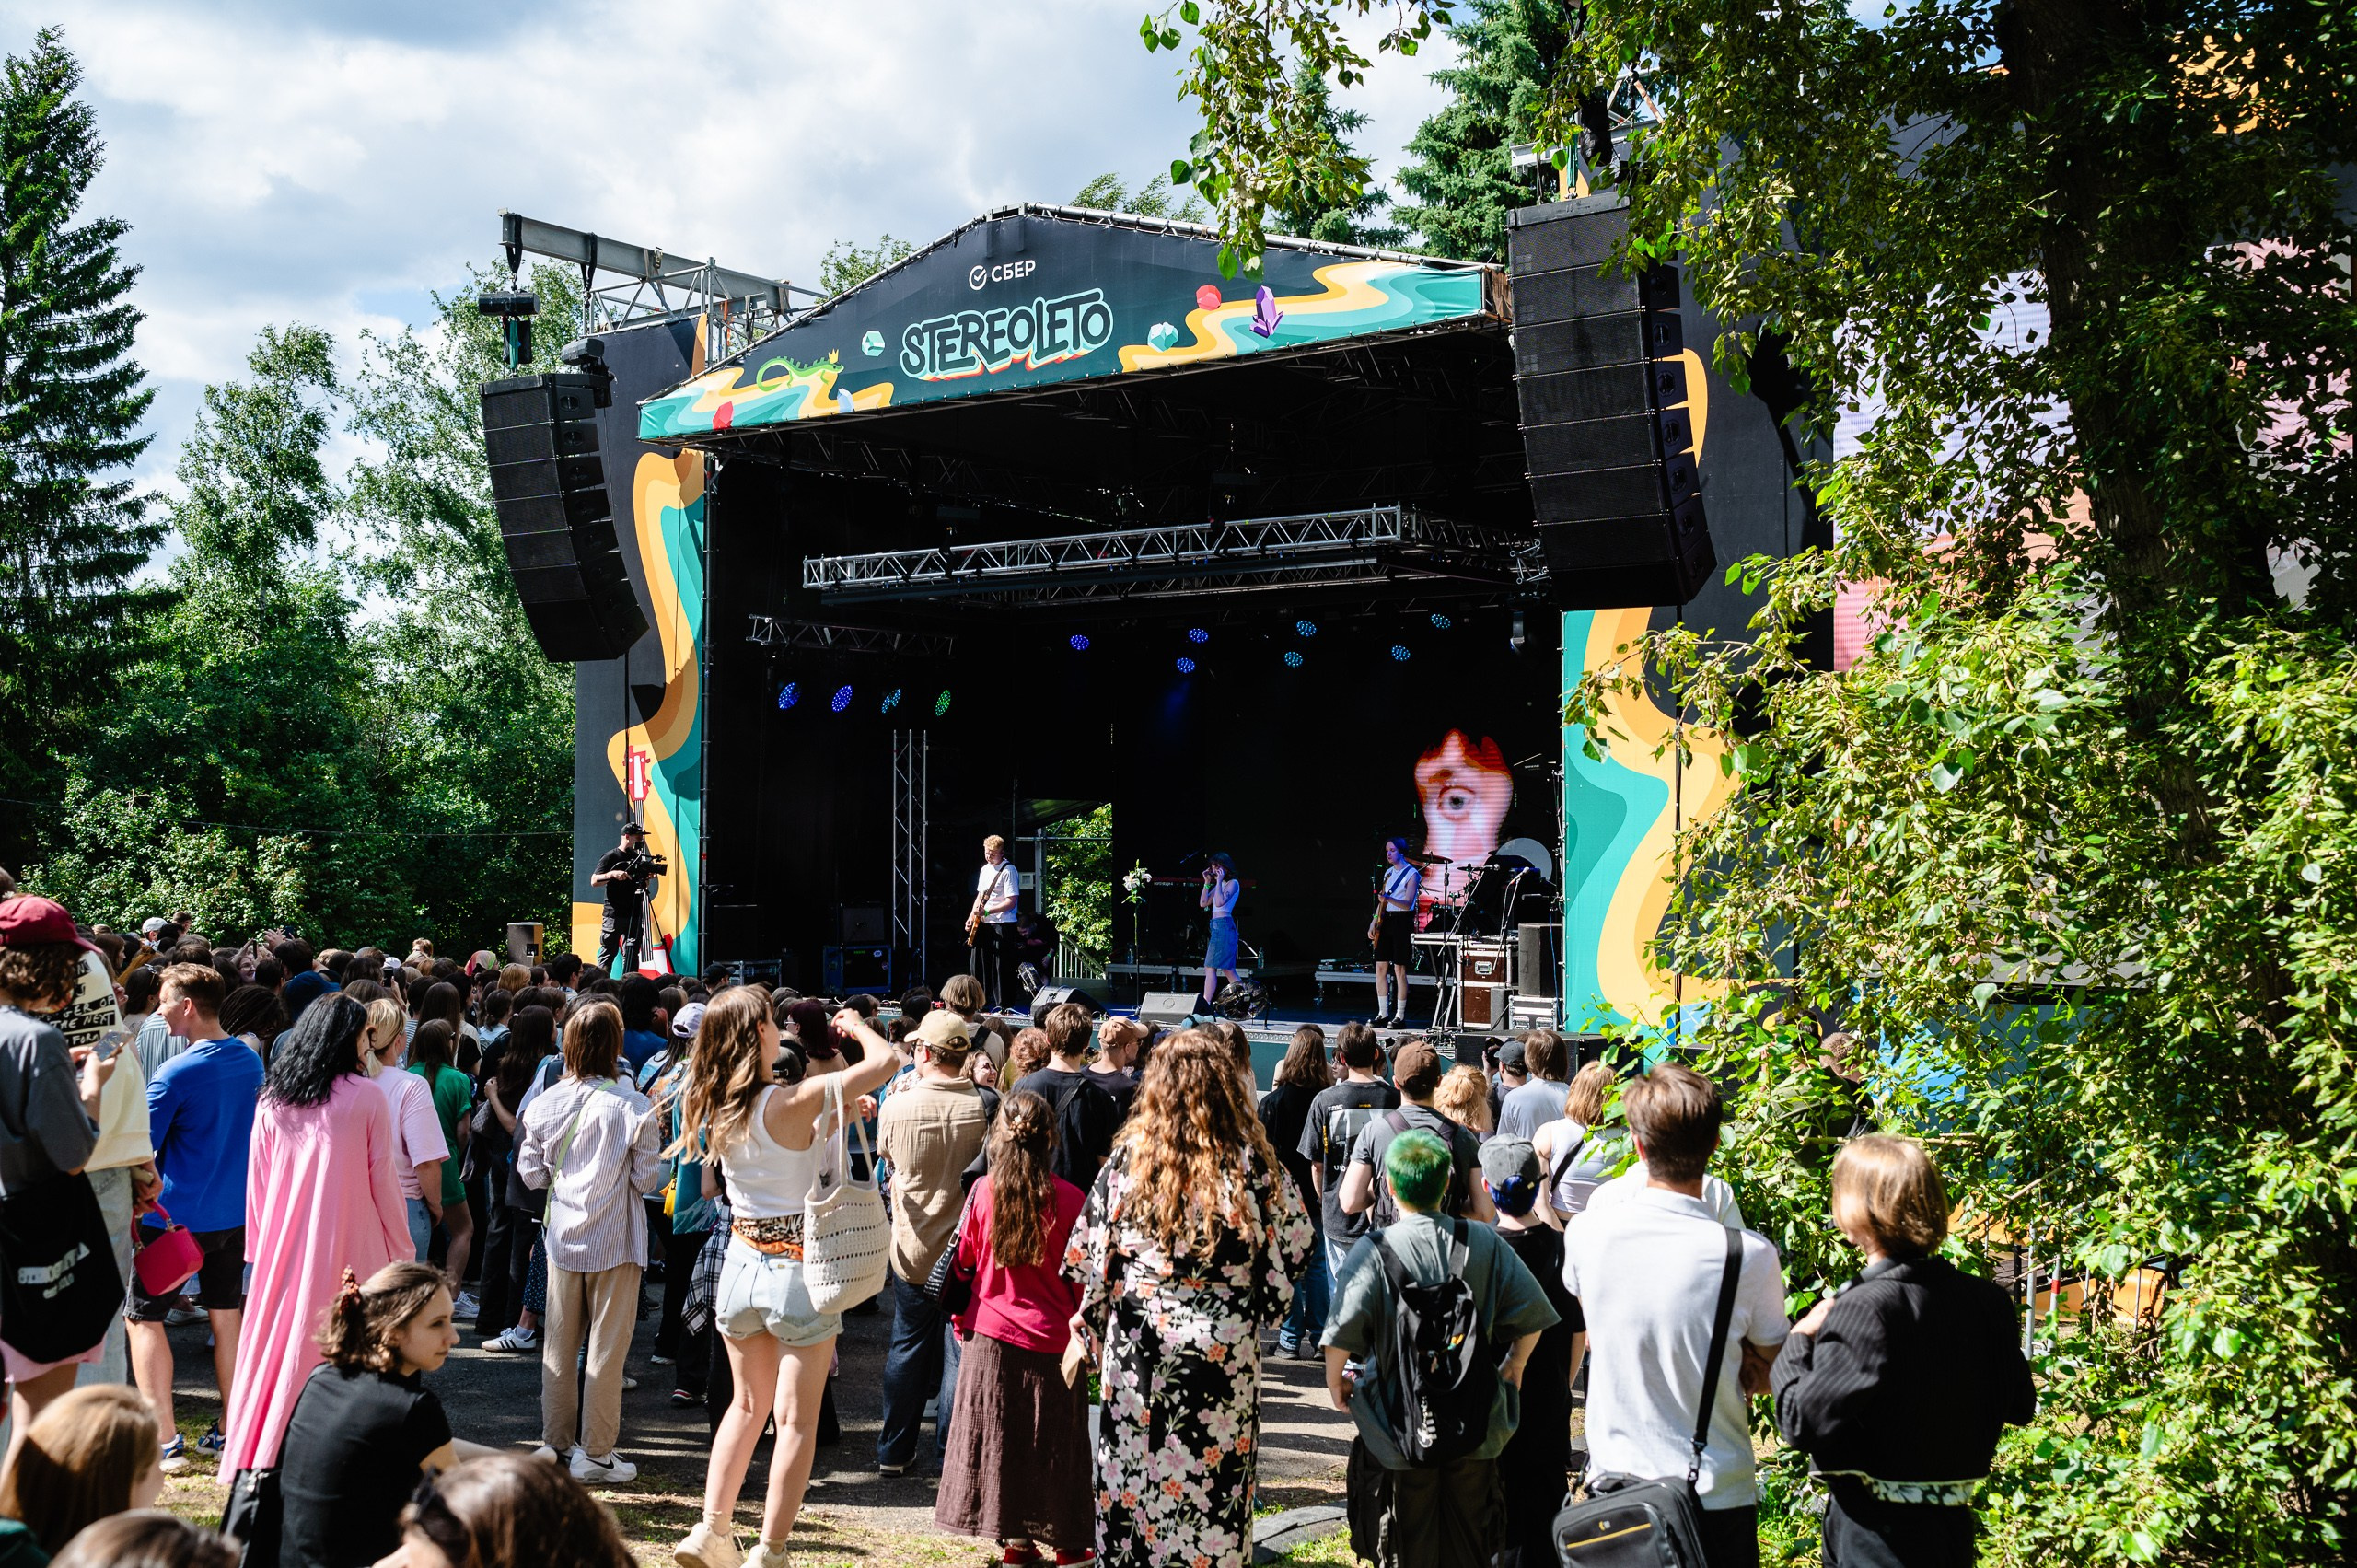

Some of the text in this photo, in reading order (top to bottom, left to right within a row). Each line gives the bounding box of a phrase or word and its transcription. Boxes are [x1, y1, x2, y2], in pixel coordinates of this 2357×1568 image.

[991, 259, 1037, 283] СБЕР
[900, 289, 1113, 378] STEREOLETO
[83, 1011, 115, 1026] NEXT
